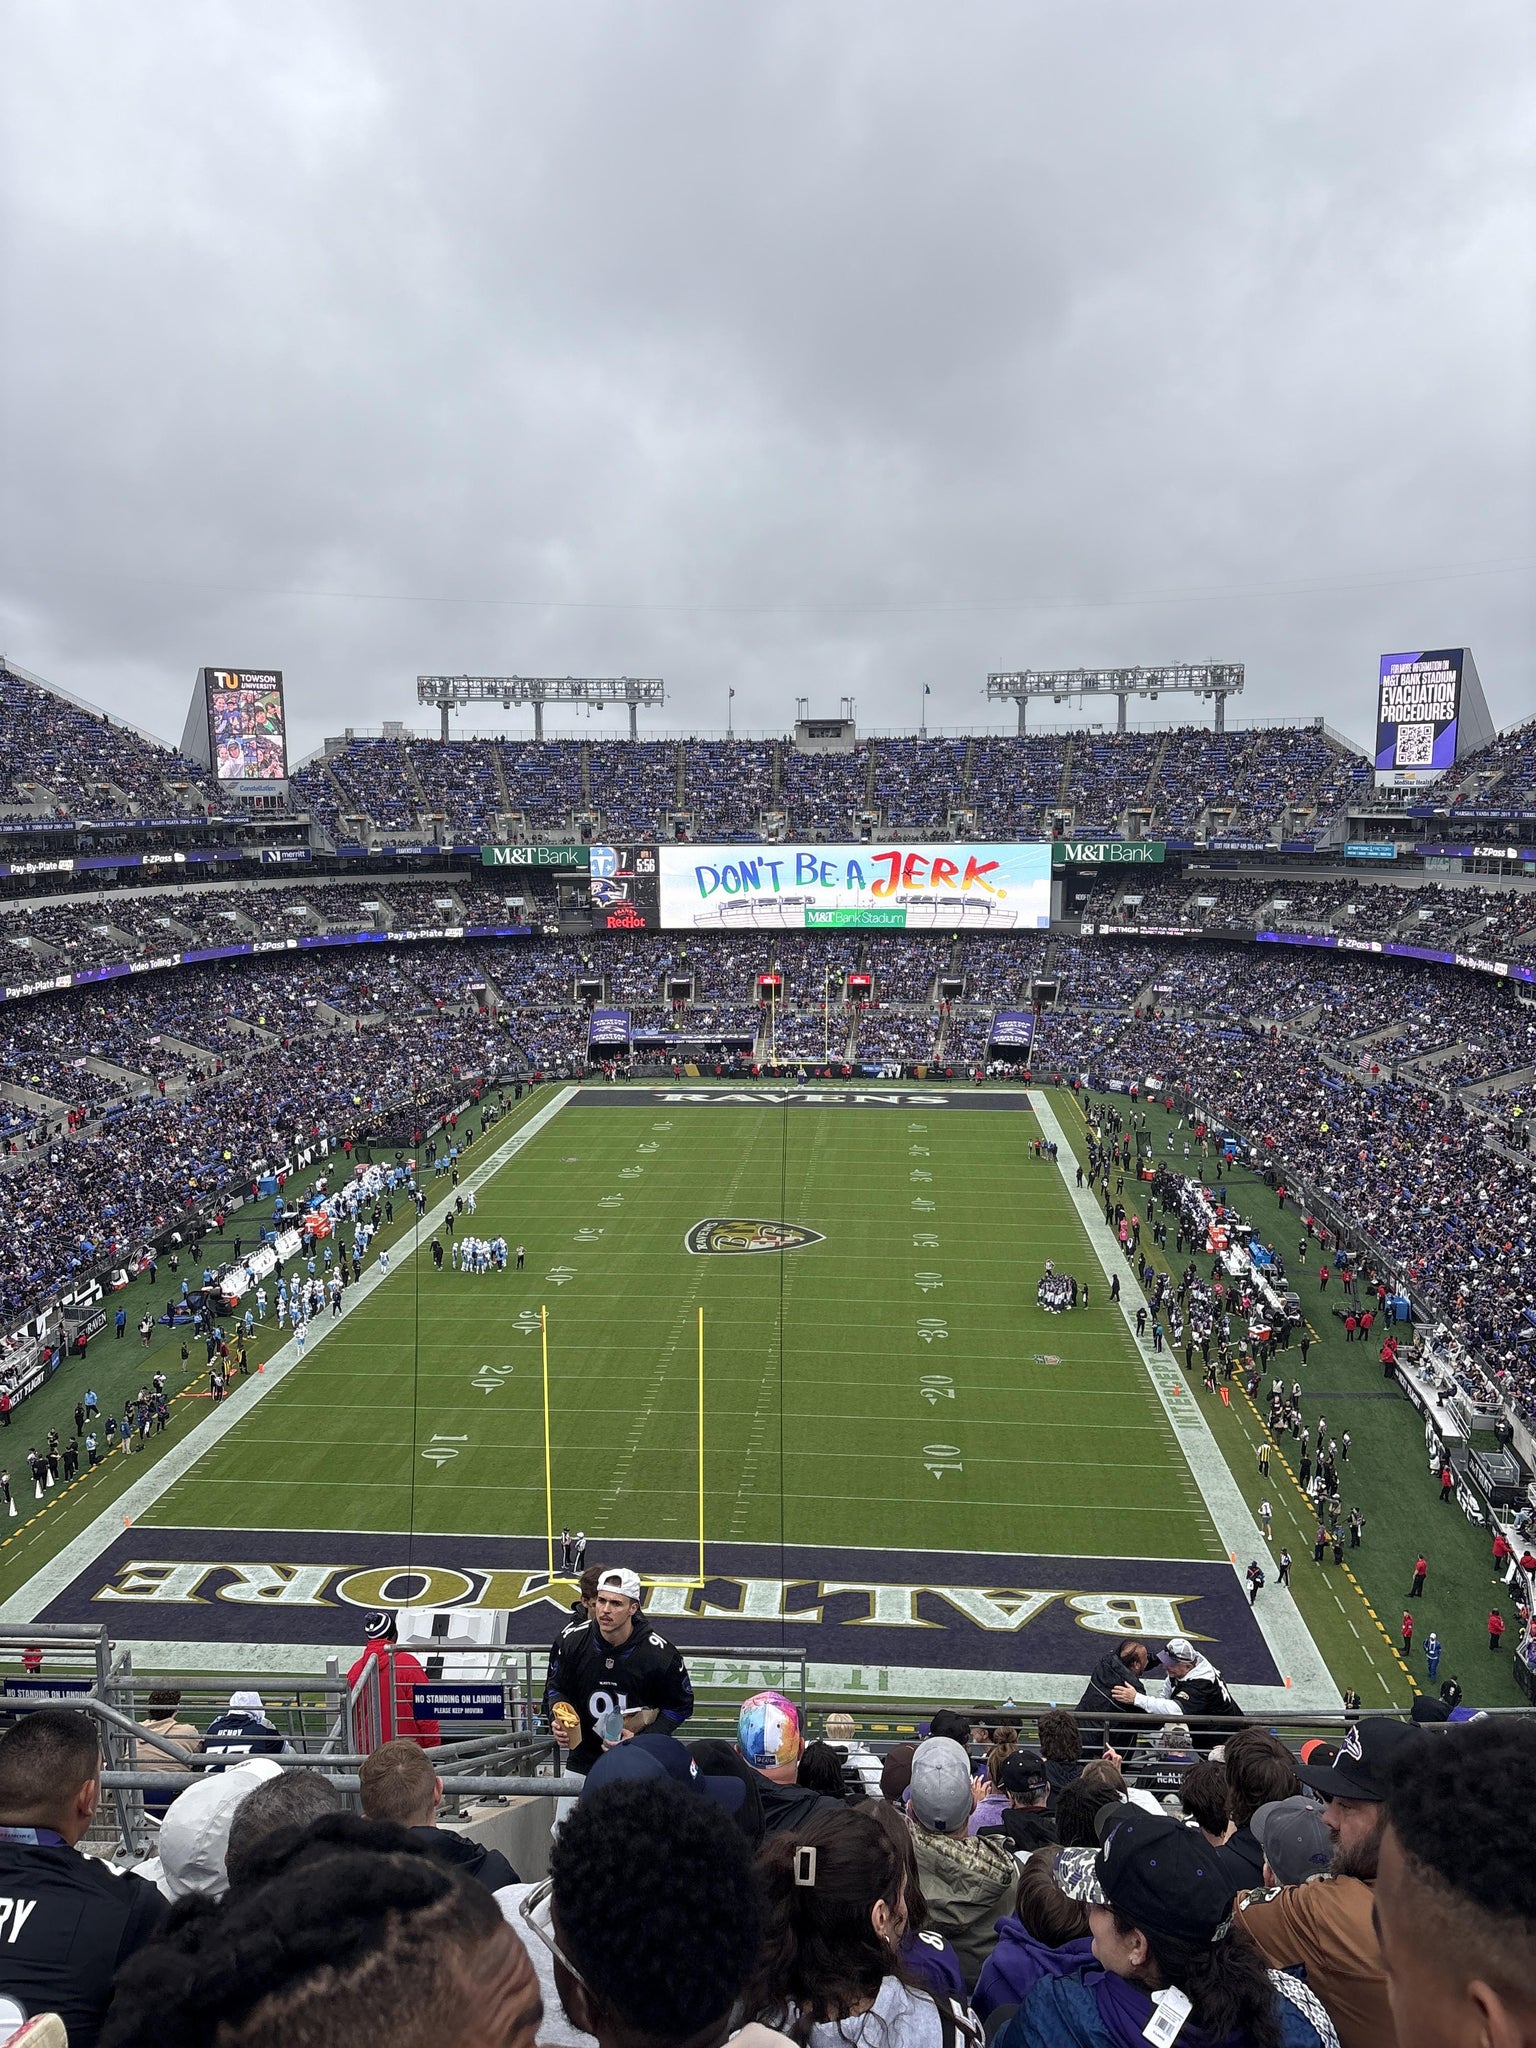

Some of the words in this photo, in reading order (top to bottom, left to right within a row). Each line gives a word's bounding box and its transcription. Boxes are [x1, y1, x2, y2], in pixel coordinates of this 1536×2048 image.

[1412, 661, 1442, 673] INFORMATION
[214, 672, 239, 689] TU
[240, 674, 276, 683] TOWSON
[1383, 674, 1400, 687] M&T
[1400, 673, 1421, 686] BANK
[1422, 670, 1456, 684] STADIUM
[1382, 683, 1456, 705] EVACUATION
[1381, 702, 1454, 723] PROCEDURES
[240, 785, 276, 793] Constellation
[143, 854, 173, 864] E-ZPass
[281, 851, 306, 859] merritt
[493, 848, 536, 864] M&T
[538, 847, 579, 864] Bank
[620, 852, 627, 869] 7
[1064, 843, 1109, 861] M&T
[1110, 843, 1154, 861] Bank
[1473, 847, 1505, 857] E-ZPass
[10, 861, 58, 875] Pay-By-Plate
[636, 859, 655, 873] 5:56
[694, 856, 784, 899] DON'T
[796, 852, 838, 887] BE
[846, 859, 867, 890] A
[871, 851, 1007, 899] JERK.
[622, 882, 628, 899] 7
[607, 916, 646, 929] RedHot
[807, 912, 835, 923] M&T
[835, 911, 862, 924] Bank
[862, 911, 904, 924] Stadium
[387, 930, 444, 941] Pay-By-Plate
[1109, 926, 1139, 934] BETMGM
[253, 940, 285, 952] E-ZPass
[1338, 939, 1370, 950] E-ZPass
[129, 961, 149, 973] Video
[149, 957, 172, 969] Tolling
[1455, 954, 1494, 972] Pay-By-Plate
[5, 979, 55, 998] Pay-By-Plate
[654, 1093, 950, 1106] RAVENS
[597, 1193, 624, 1208] 40
[572, 1227, 605, 1242] 50
[696, 1222, 719, 1251] RAVENS
[912, 1232, 939, 1248] 50
[545, 1265, 578, 1282] 40
[914, 1271, 944, 1289] 40
[511, 1310, 549, 1332] 30
[916, 1317, 948, 1339] 30
[24, 1371, 45, 1396] FLIGHT
[470, 1364, 514, 1389] 20
[918, 1374, 955, 1400] 20
[1148, 1357, 1204, 1430] INTERCEPT
[421, 1433, 469, 1461] 10
[922, 1444, 963, 1472] 10
[92, 1559, 1220, 1642] BALTIMORE
[648, 1632, 669, 1649] 91
[843, 1669, 889, 1691] IT
[6, 1688, 16, 1698] NO
[17, 1689, 50, 1698] STANDING
[51, 1690, 60, 1698] ON
[415, 1695, 425, 1704] NO
[426, 1694, 460, 1704] STANDING
[461, 1694, 471, 1704] ON
[473, 1695, 502, 1704] LANDING
[217, 1728, 243, 1737] HENRY
